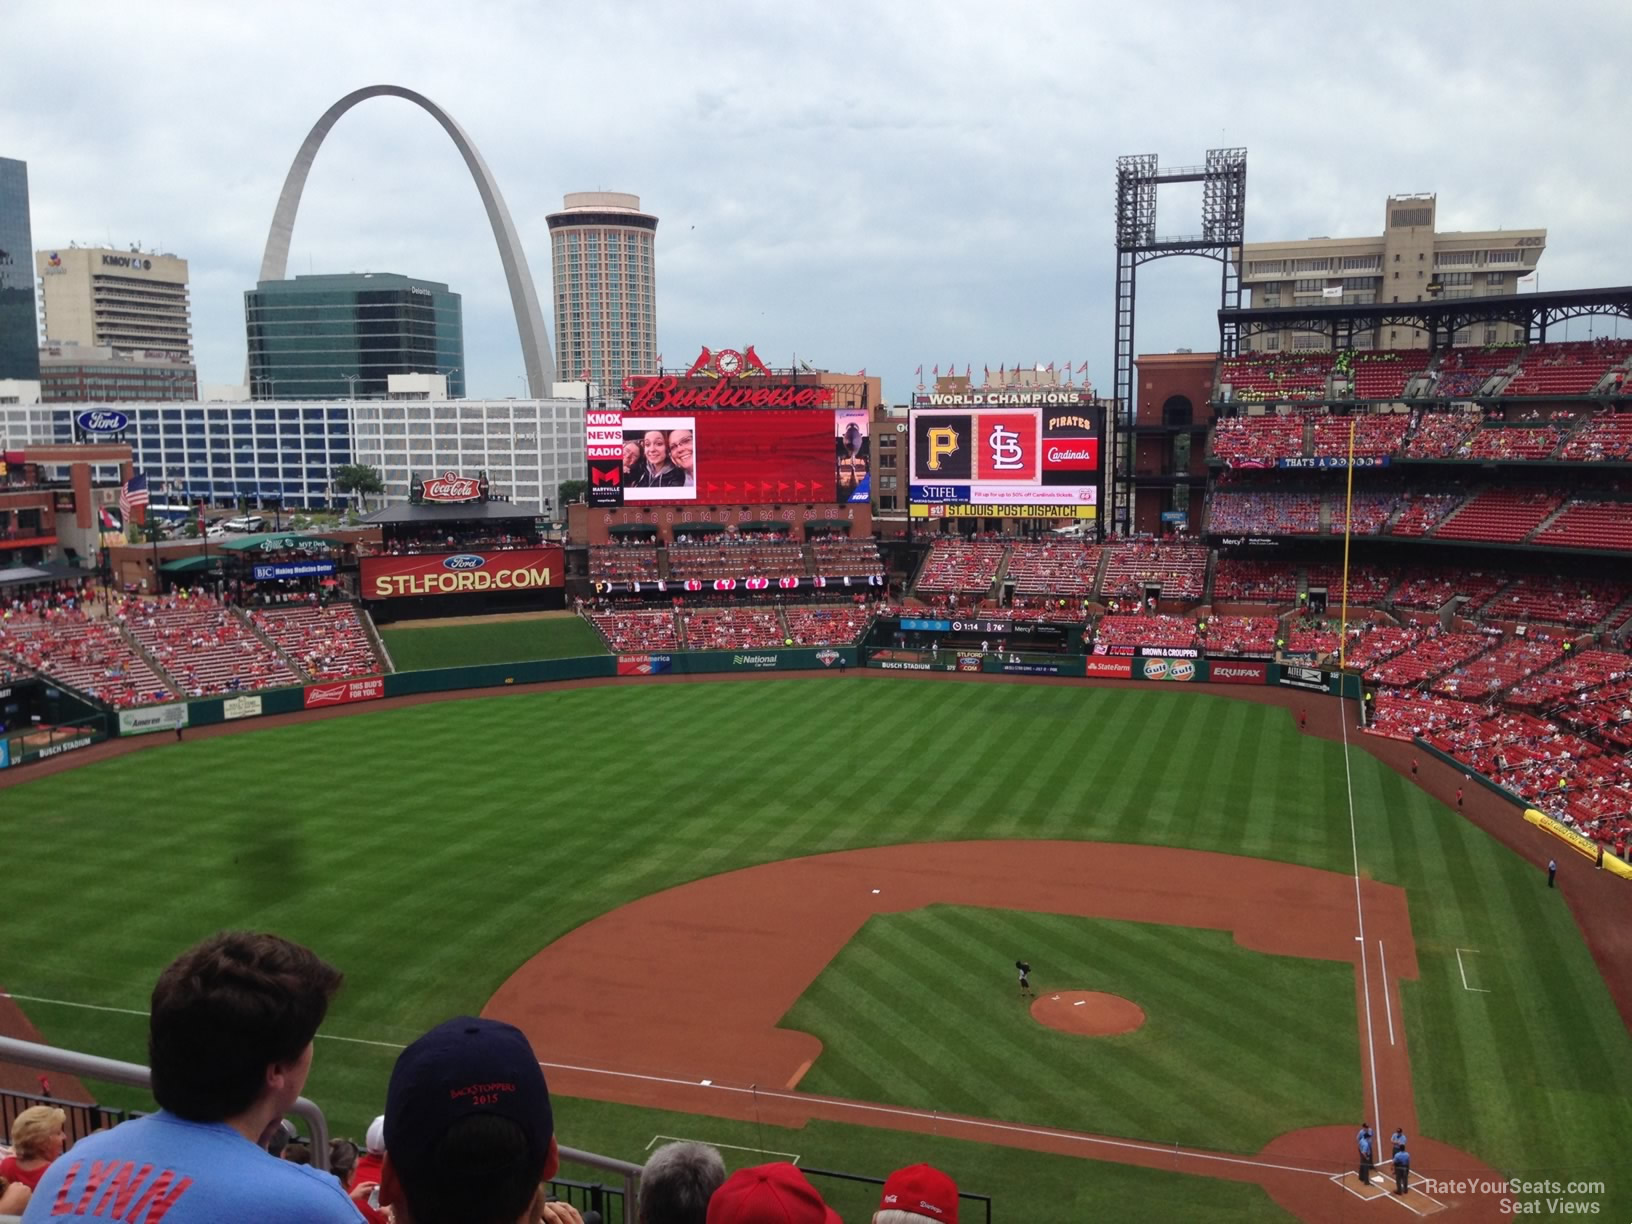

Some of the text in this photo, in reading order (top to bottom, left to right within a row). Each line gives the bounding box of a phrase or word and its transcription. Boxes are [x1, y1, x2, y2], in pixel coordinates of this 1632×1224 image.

[102, 254, 130, 267] KMOV
[622, 376, 835, 411] Budweiser
[929, 392, 1079, 405] WORLD CHAMPIONS
[89, 412, 119, 429] Ford
[587, 414, 622, 424] KMOX
[1049, 416, 1091, 431] PIRATES
[588, 431, 622, 440] NEWS
[588, 448, 622, 456] RADIO
[927, 426, 959, 471] P
[1048, 447, 1090, 463] Cardinals
[1285, 458, 1315, 466] THAT'S
[430, 481, 473, 497] Coca-Cola
[922, 485, 957, 498] STIFEL
[682, 511, 692, 521] 10
[701, 511, 711, 521] 14
[720, 511, 730, 521] 17
[739, 511, 751, 521] 20
[760, 510, 774, 520] 24
[782, 510, 795, 520] 42
[949, 504, 1077, 517] ST. LOUIS POST-DISPATCH
[451, 557, 476, 568] Ford
[257, 567, 272, 577] BJC
[376, 568, 550, 595] STLFORD.COM
[1014, 625, 1031, 635] Mercy
[1142, 647, 1162, 656] BROWN
[643, 655, 671, 663] America
[743, 654, 777, 665] National
[1145, 664, 1166, 673] Gulf
[1171, 665, 1192, 675] Gulf
[1213, 667, 1261, 678] EQUIFAX
[349, 680, 383, 693] THIS BUD'S
[350, 687, 377, 701] FOR YOU.
[132, 717, 160, 728] Ameren
[40, 737, 91, 758] BUSCH STADIUM
[472, 1094, 498, 1105] 2015
[51, 1159, 194, 1224] LYNN
